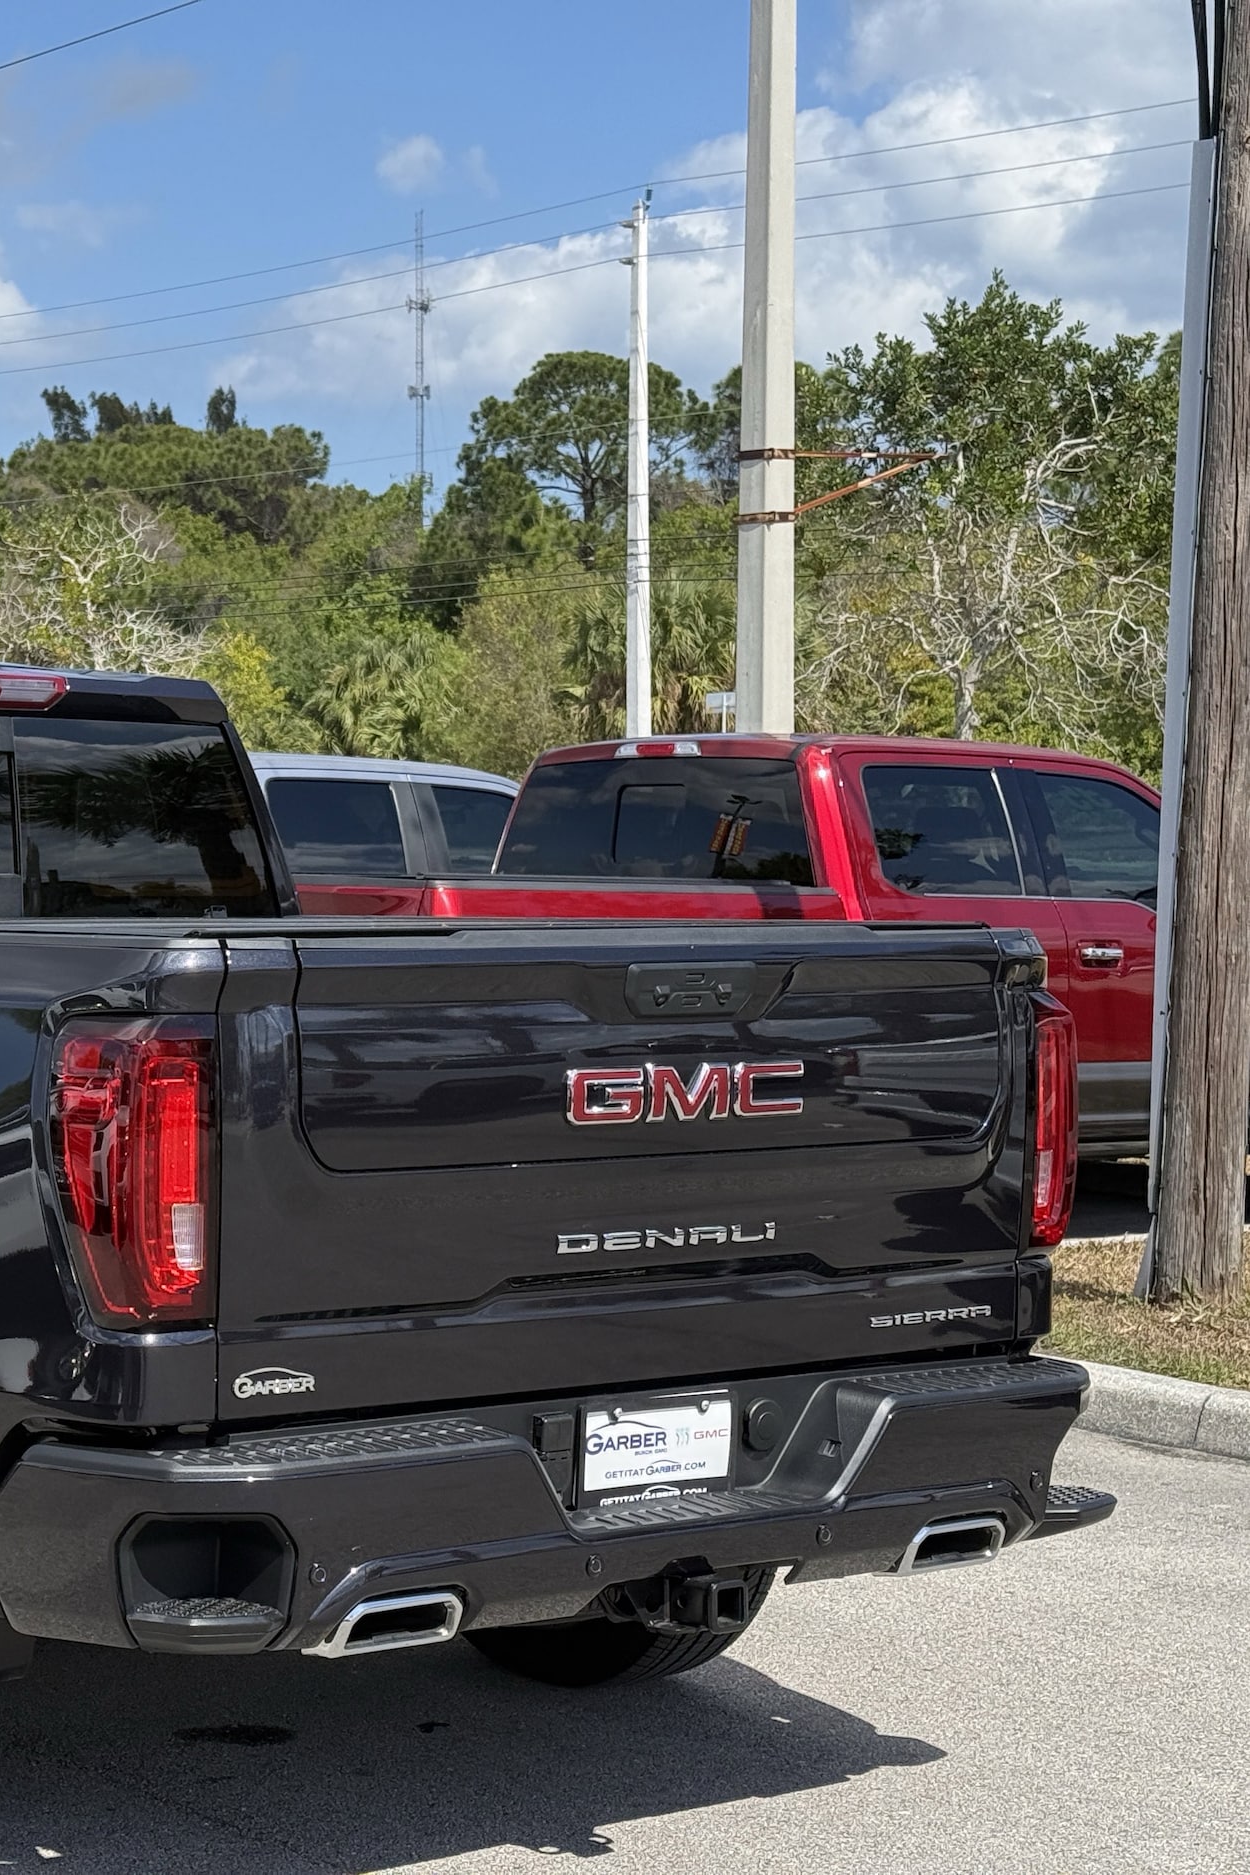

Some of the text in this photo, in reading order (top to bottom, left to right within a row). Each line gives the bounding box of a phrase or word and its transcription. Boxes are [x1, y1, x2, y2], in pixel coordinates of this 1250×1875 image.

[564, 1059, 804, 1126] GMC
[557, 1221, 776, 1254] DENALI
[870, 1305, 991, 1328] SIERRA
[234, 1377, 315, 1399] GARBER
[585, 1431, 667, 1455] GARBER
[694, 1429, 728, 1440] GMC
[600, 1487, 707, 1507] GETITATGARBERCOM
